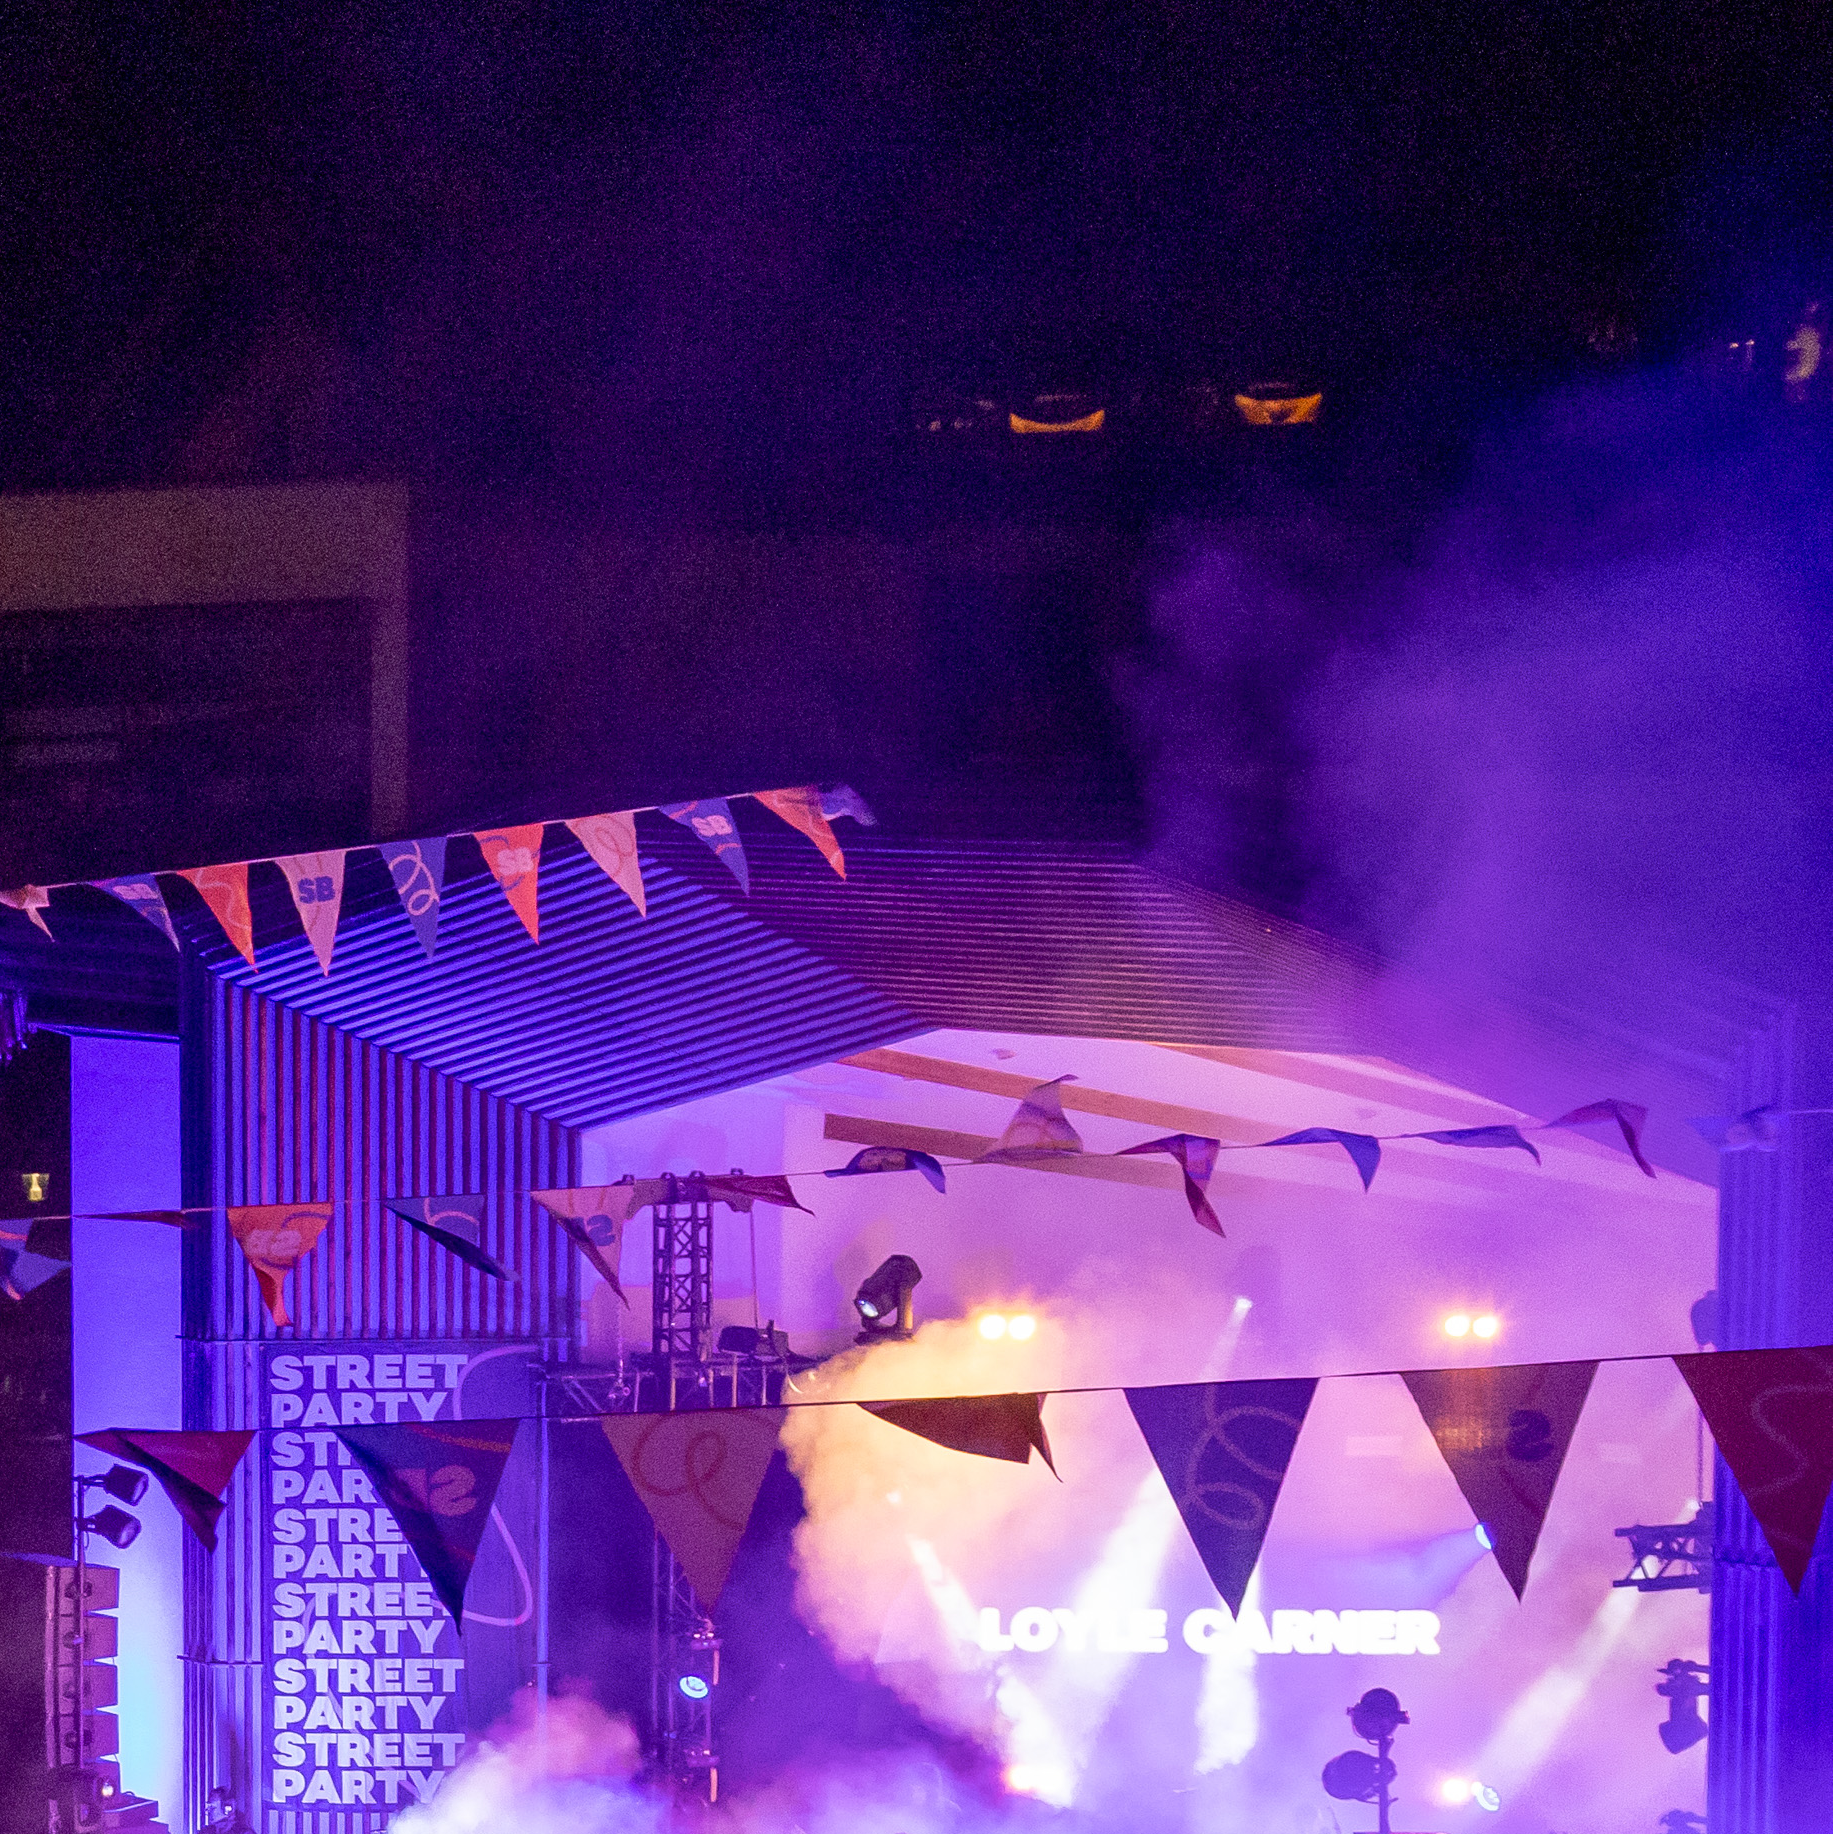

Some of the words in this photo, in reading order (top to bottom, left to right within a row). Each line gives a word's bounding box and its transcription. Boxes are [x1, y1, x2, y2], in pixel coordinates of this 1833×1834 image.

[496, 848, 535, 875] SB
[298, 875, 336, 903] SB
[270, 1354, 468, 1390] STREET
[271, 1392, 447, 1428] PARTY
[272, 1469, 376, 1504] PAR
[273, 1508, 407, 1543] STRE
[273, 1544, 428, 1578] PART
[272, 1582, 452, 1618] STREE
[273, 1619, 445, 1654] PARTY
[979, 1607, 1169, 1653] LOYLE
[1183, 1608, 1441, 1655] CARNER
[273, 1657, 465, 1693] STREET
[274, 1695, 446, 1730] PARTY
[273, 1731, 465, 1767] STREET
[273, 1769, 445, 1804] PARTY
